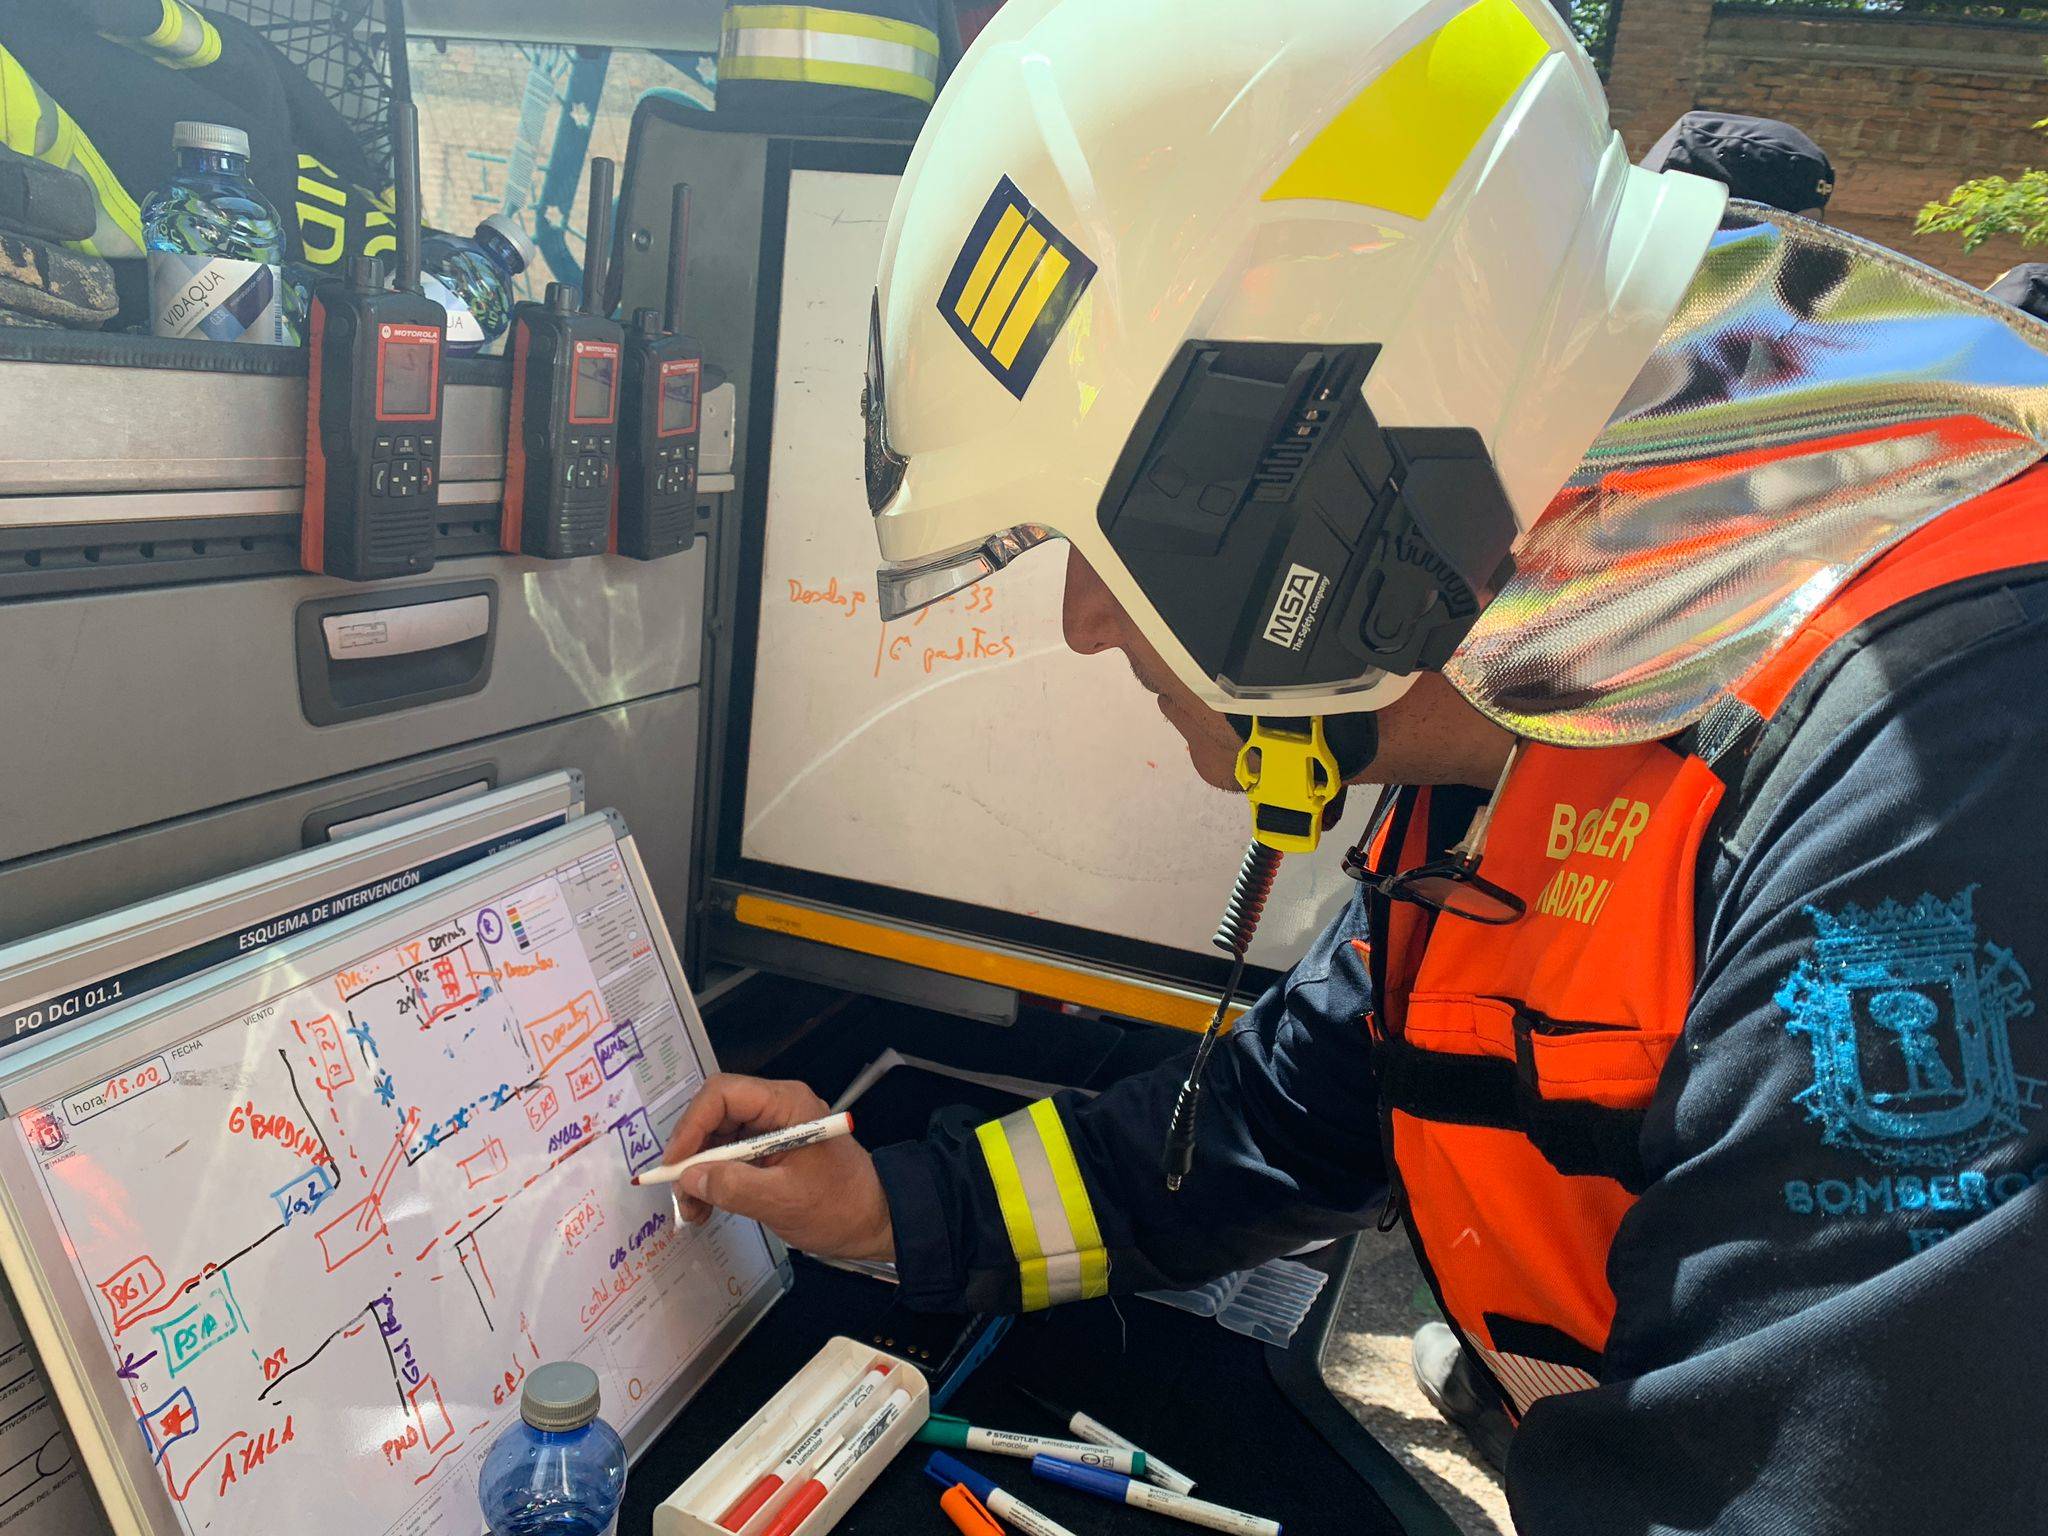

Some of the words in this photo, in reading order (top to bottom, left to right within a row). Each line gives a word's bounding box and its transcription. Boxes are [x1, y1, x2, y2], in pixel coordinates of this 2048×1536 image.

[163, 270, 225, 328] VIDAQUA
[393, 329, 438, 340] MOTOROLA
[585, 345, 617, 354] MOTOROLA
[1269, 574, 1314, 643] MSA
[1292, 638, 1303, 652] The
[1299, 613, 1316, 638] Safety
[1309, 575, 1331, 613] Company
[238, 914, 310, 951] ESQUEMA
[312, 904, 329, 923] DE
[332, 870, 421, 919] INTERVENCIÓN
[14, 1010, 43, 1035] PO
[48, 998, 81, 1023] DCI
[85, 981, 123, 1011] 01.1
[243, 1006, 275, 1026] VIENTO
[171, 1039, 203, 1061] FECHA
[790, 1427, 824, 1461] STAEDTLER
[991, 1438, 1030, 1451] Lumocolor
[993, 1430, 1039, 1444] STAEDTLER
[1041, 1440, 1081, 1451] whiteboard
[1080, 1443, 1110, 1456] compact
